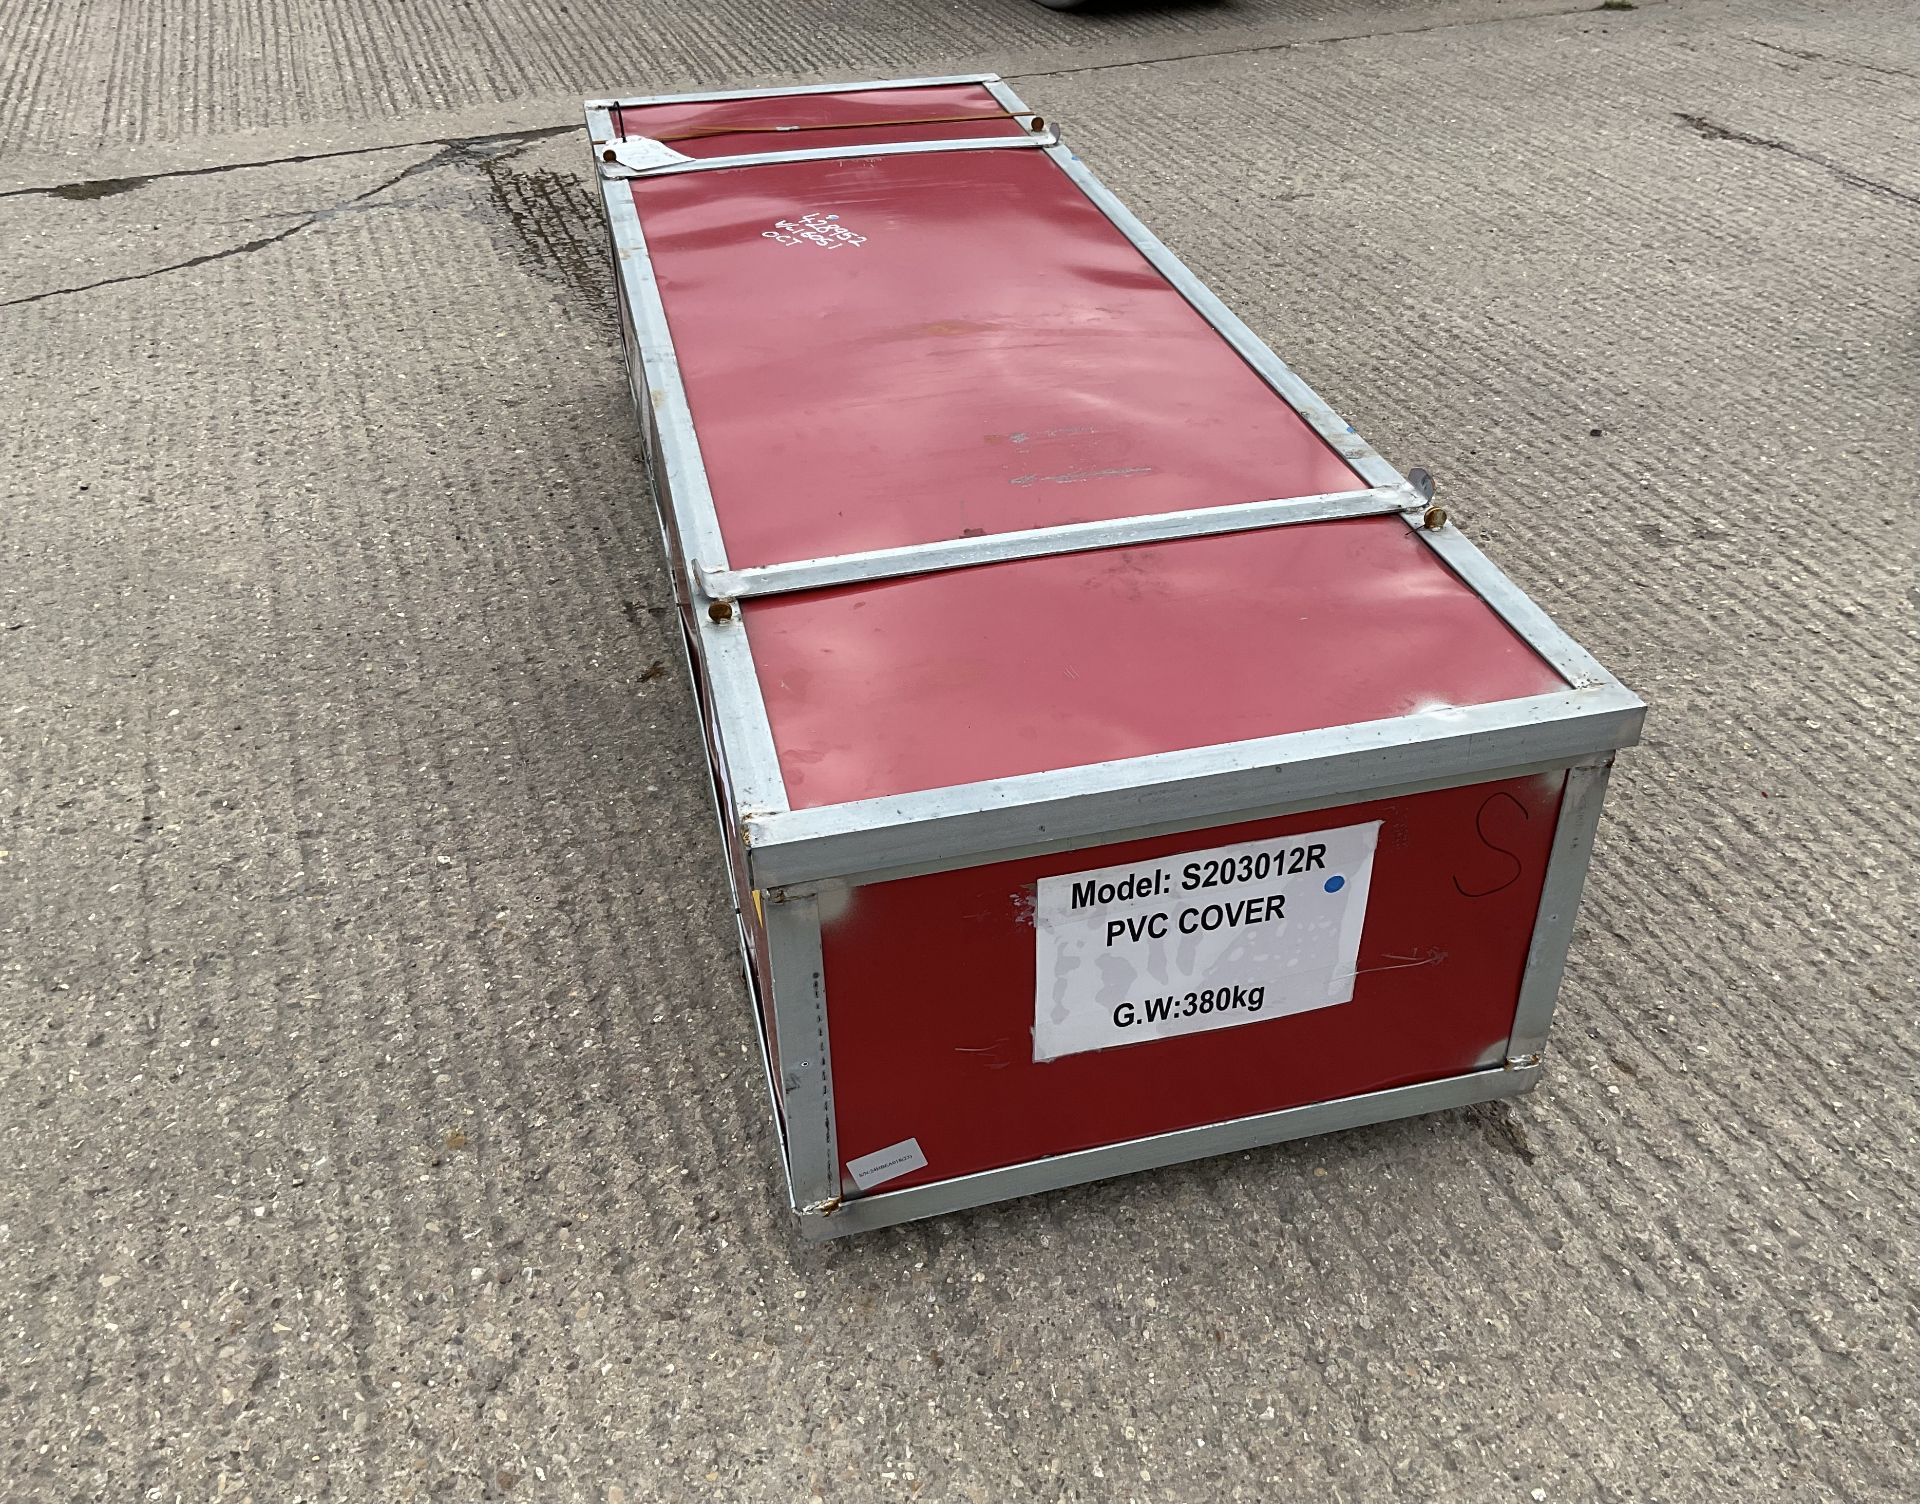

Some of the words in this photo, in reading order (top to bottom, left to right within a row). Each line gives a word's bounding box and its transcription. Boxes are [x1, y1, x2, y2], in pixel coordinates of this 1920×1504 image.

[762, 231, 802, 246] OCT
[1071, 869, 1170, 909] Model:
[1181, 844, 1326, 892] S203012R
[1106, 912, 1168, 946] PVC
[1178, 895, 1285, 934] COVER
[1113, 985, 1265, 1027] G.W:380kg
